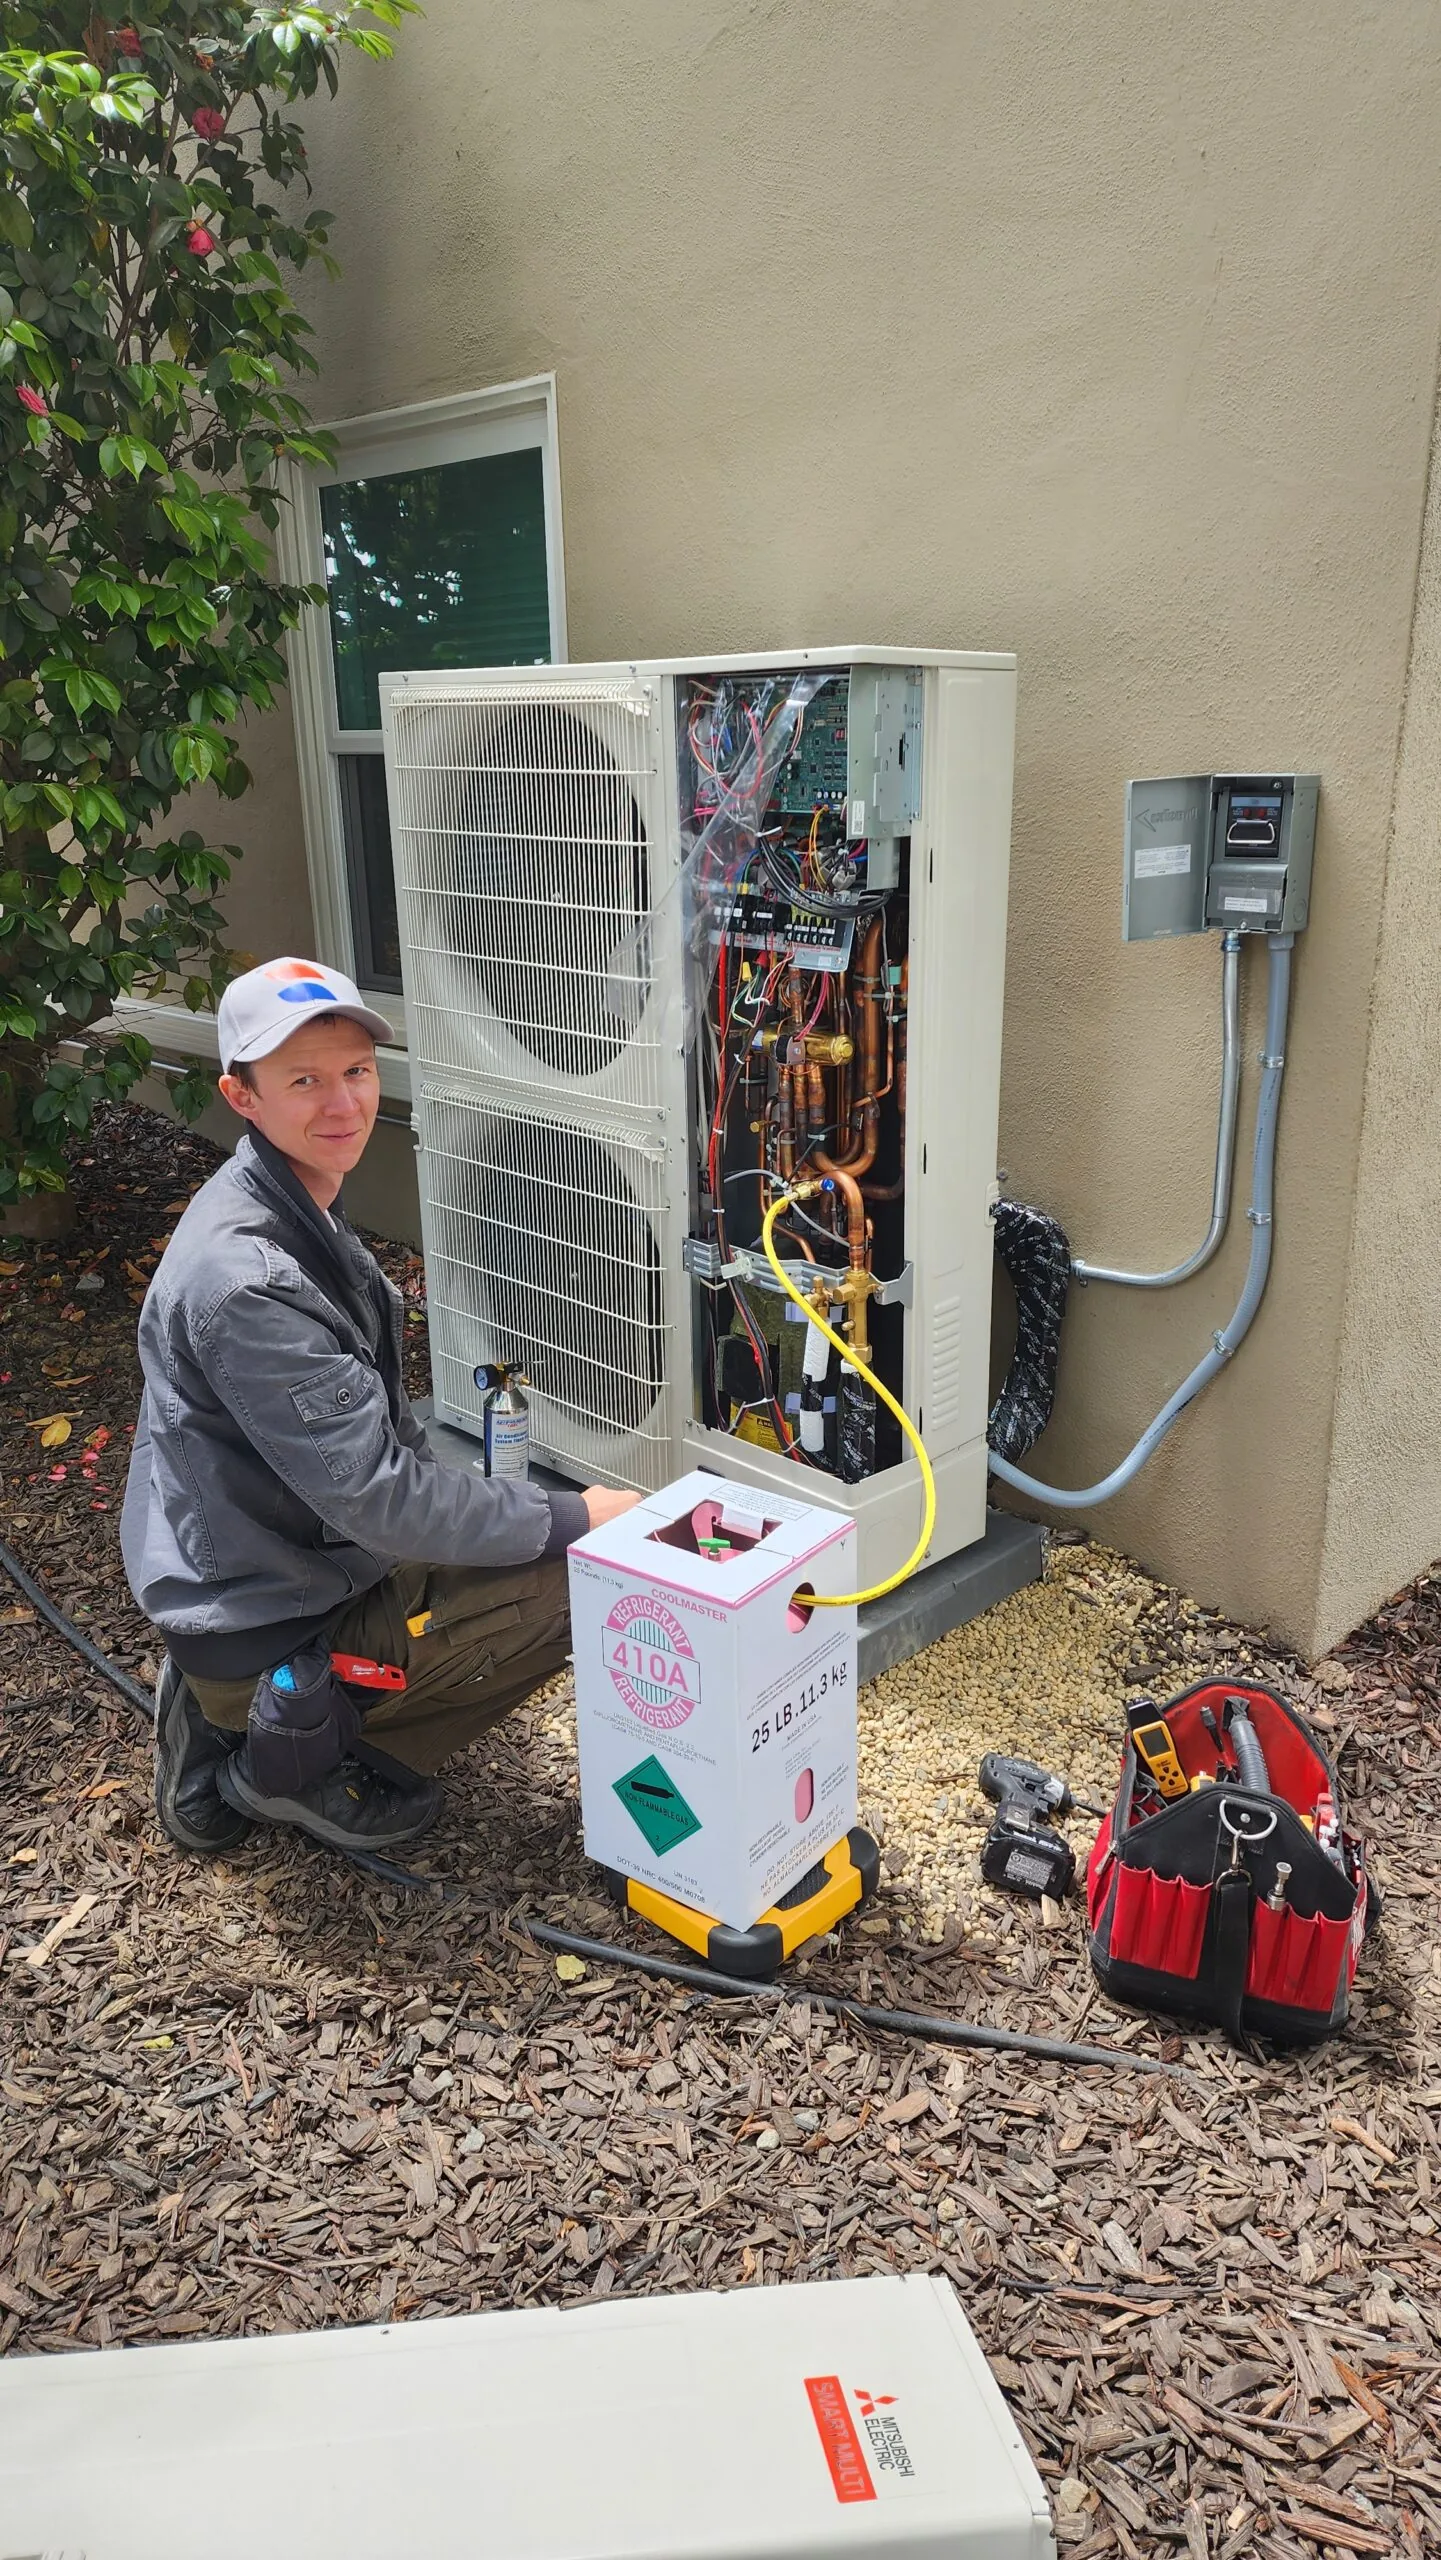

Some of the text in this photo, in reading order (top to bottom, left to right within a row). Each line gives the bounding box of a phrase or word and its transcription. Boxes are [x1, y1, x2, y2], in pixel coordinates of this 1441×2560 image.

[612, 1596, 690, 1649] REFRIGERANT
[651, 1588, 727, 1624] COOLMASTER
[612, 1642, 688, 1692] 410A
[614, 1677, 690, 1728] REFRIGERANT
[752, 1720, 770, 1753] 25
[832, 1661, 847, 1686] kg
[786, 1713, 816, 1742] MADE IN USA
[676, 1812, 688, 1826] GAS
[642, 1866, 655, 1880] NRC
[760, 1879, 767, 1891] NE
[769, 1868, 780, 1883] PAS
[781, 1843, 806, 1872] STOCKER
[812, 1826, 824, 1844] PLUS
[766, 1864, 774, 1876] DO
[776, 1853, 786, 1867] NOT
[790, 1836, 805, 1856] STORE
[808, 1819, 823, 1838] ABOVE
[673, 1869, 682, 1879] UN
[812, 2382, 848, 2439] SMART
[833, 2442, 866, 2494] MULTI
[864, 2418, 895, 2470] ELECTRIC
[880, 2416, 915, 2477] MITSUBISHI
